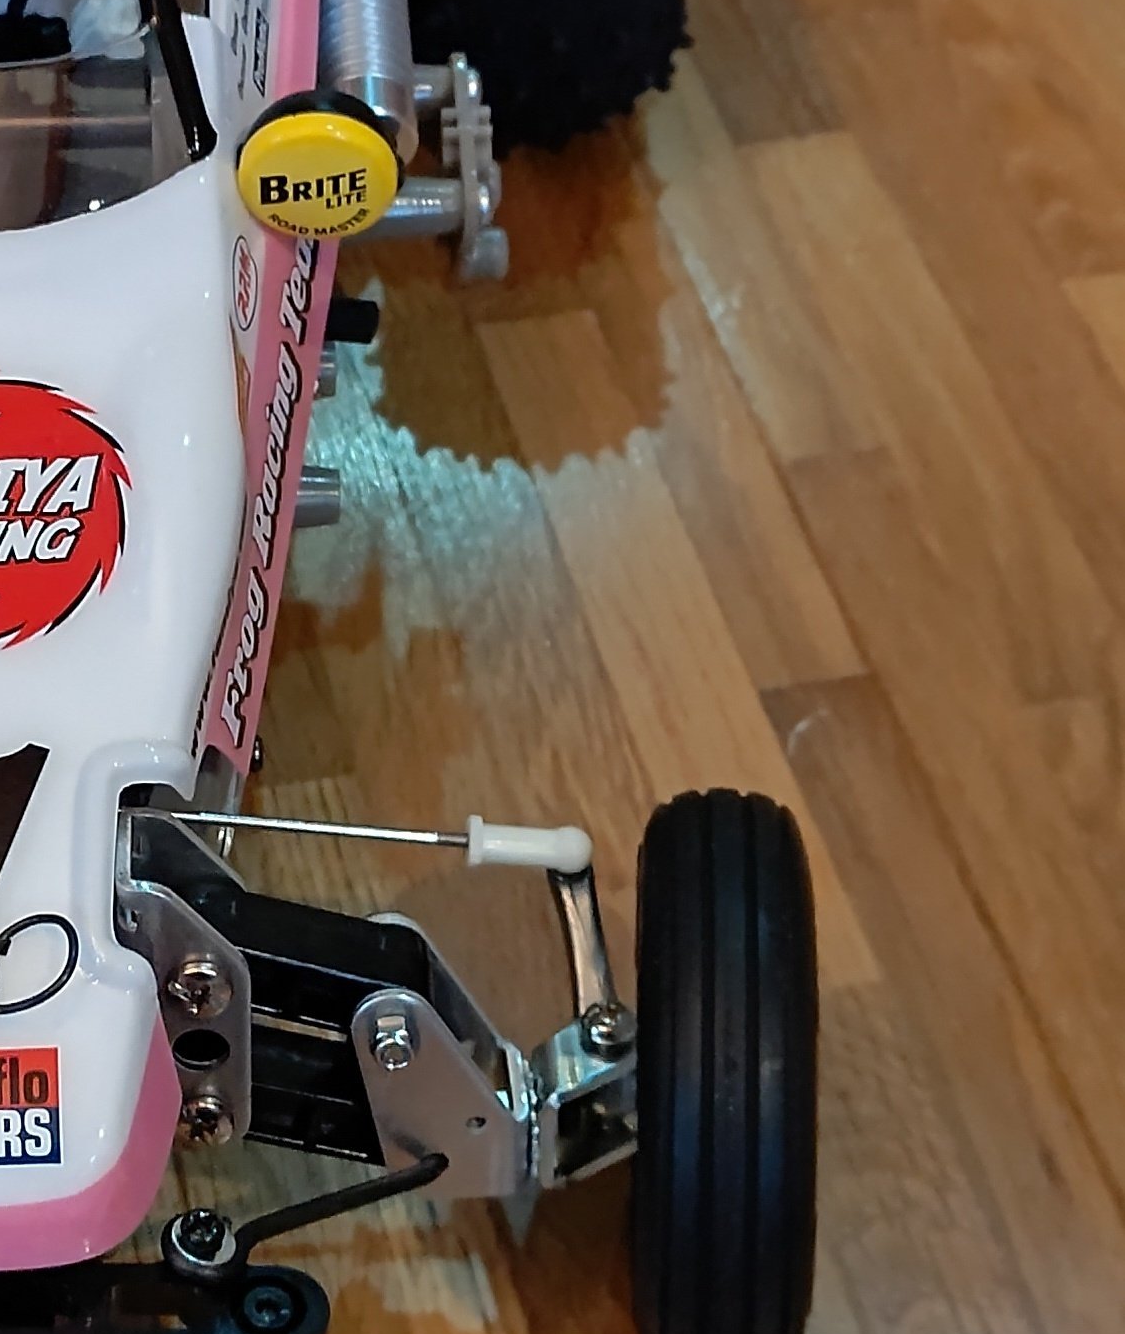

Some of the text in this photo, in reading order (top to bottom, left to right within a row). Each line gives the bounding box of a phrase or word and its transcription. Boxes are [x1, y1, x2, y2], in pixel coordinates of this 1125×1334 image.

[258, 167, 368, 206] BRITE
[324, 190, 368, 210] LITE
[267, 207, 371, 236] ROAD MASTER
[217, 237, 321, 749] Frog Racing Tea
